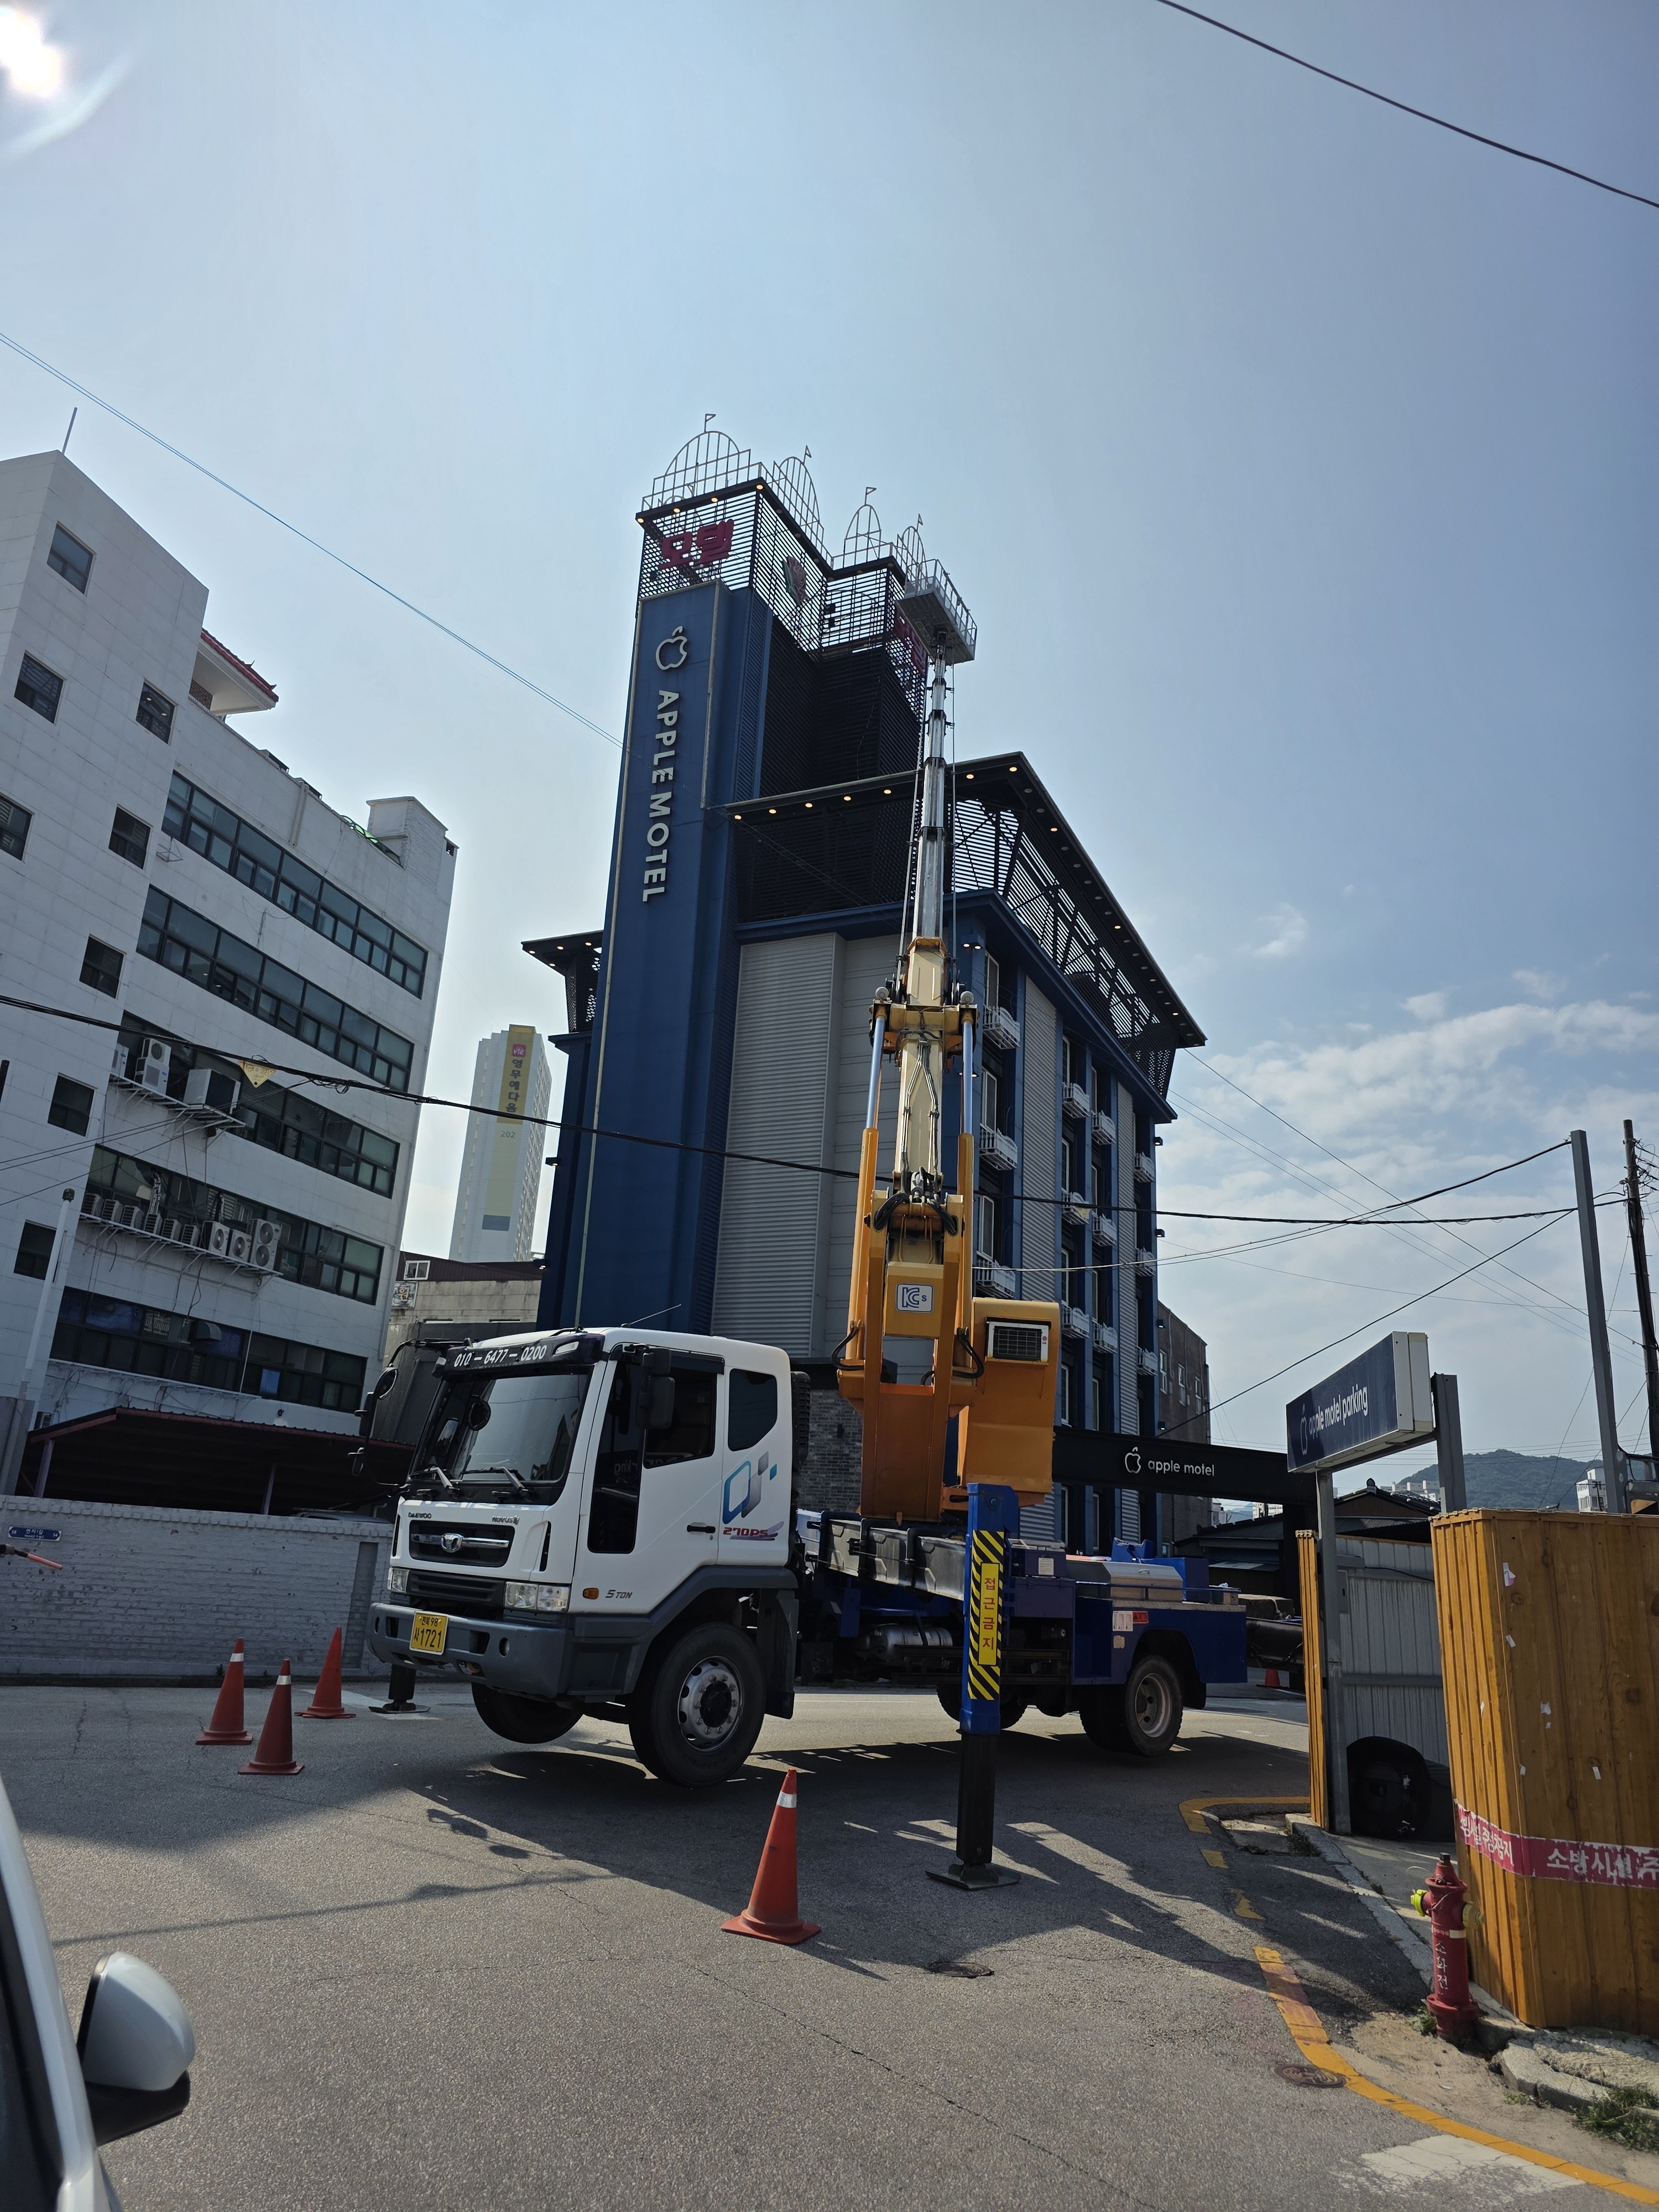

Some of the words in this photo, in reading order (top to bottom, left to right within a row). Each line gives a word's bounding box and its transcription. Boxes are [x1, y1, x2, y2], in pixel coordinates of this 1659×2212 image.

[658, 518, 734, 570] 모텔
[651, 690, 679, 784] APPLE
[642, 791, 672, 902] MOTEL
[505, 1058, 524, 1113] 영무예다음
[500, 1130, 516, 1139] 202
[1308, 1405, 1324, 1440] apple
[1324, 1394, 1342, 1428] motel
[1342, 1383, 1368, 1426] parking
[1147, 1459, 1181, 1474] apple
[1184, 1463, 1214, 1477] motel
[723, 1526, 768, 1538] 270PS
[982, 1578, 995, 1650] 접근금지
